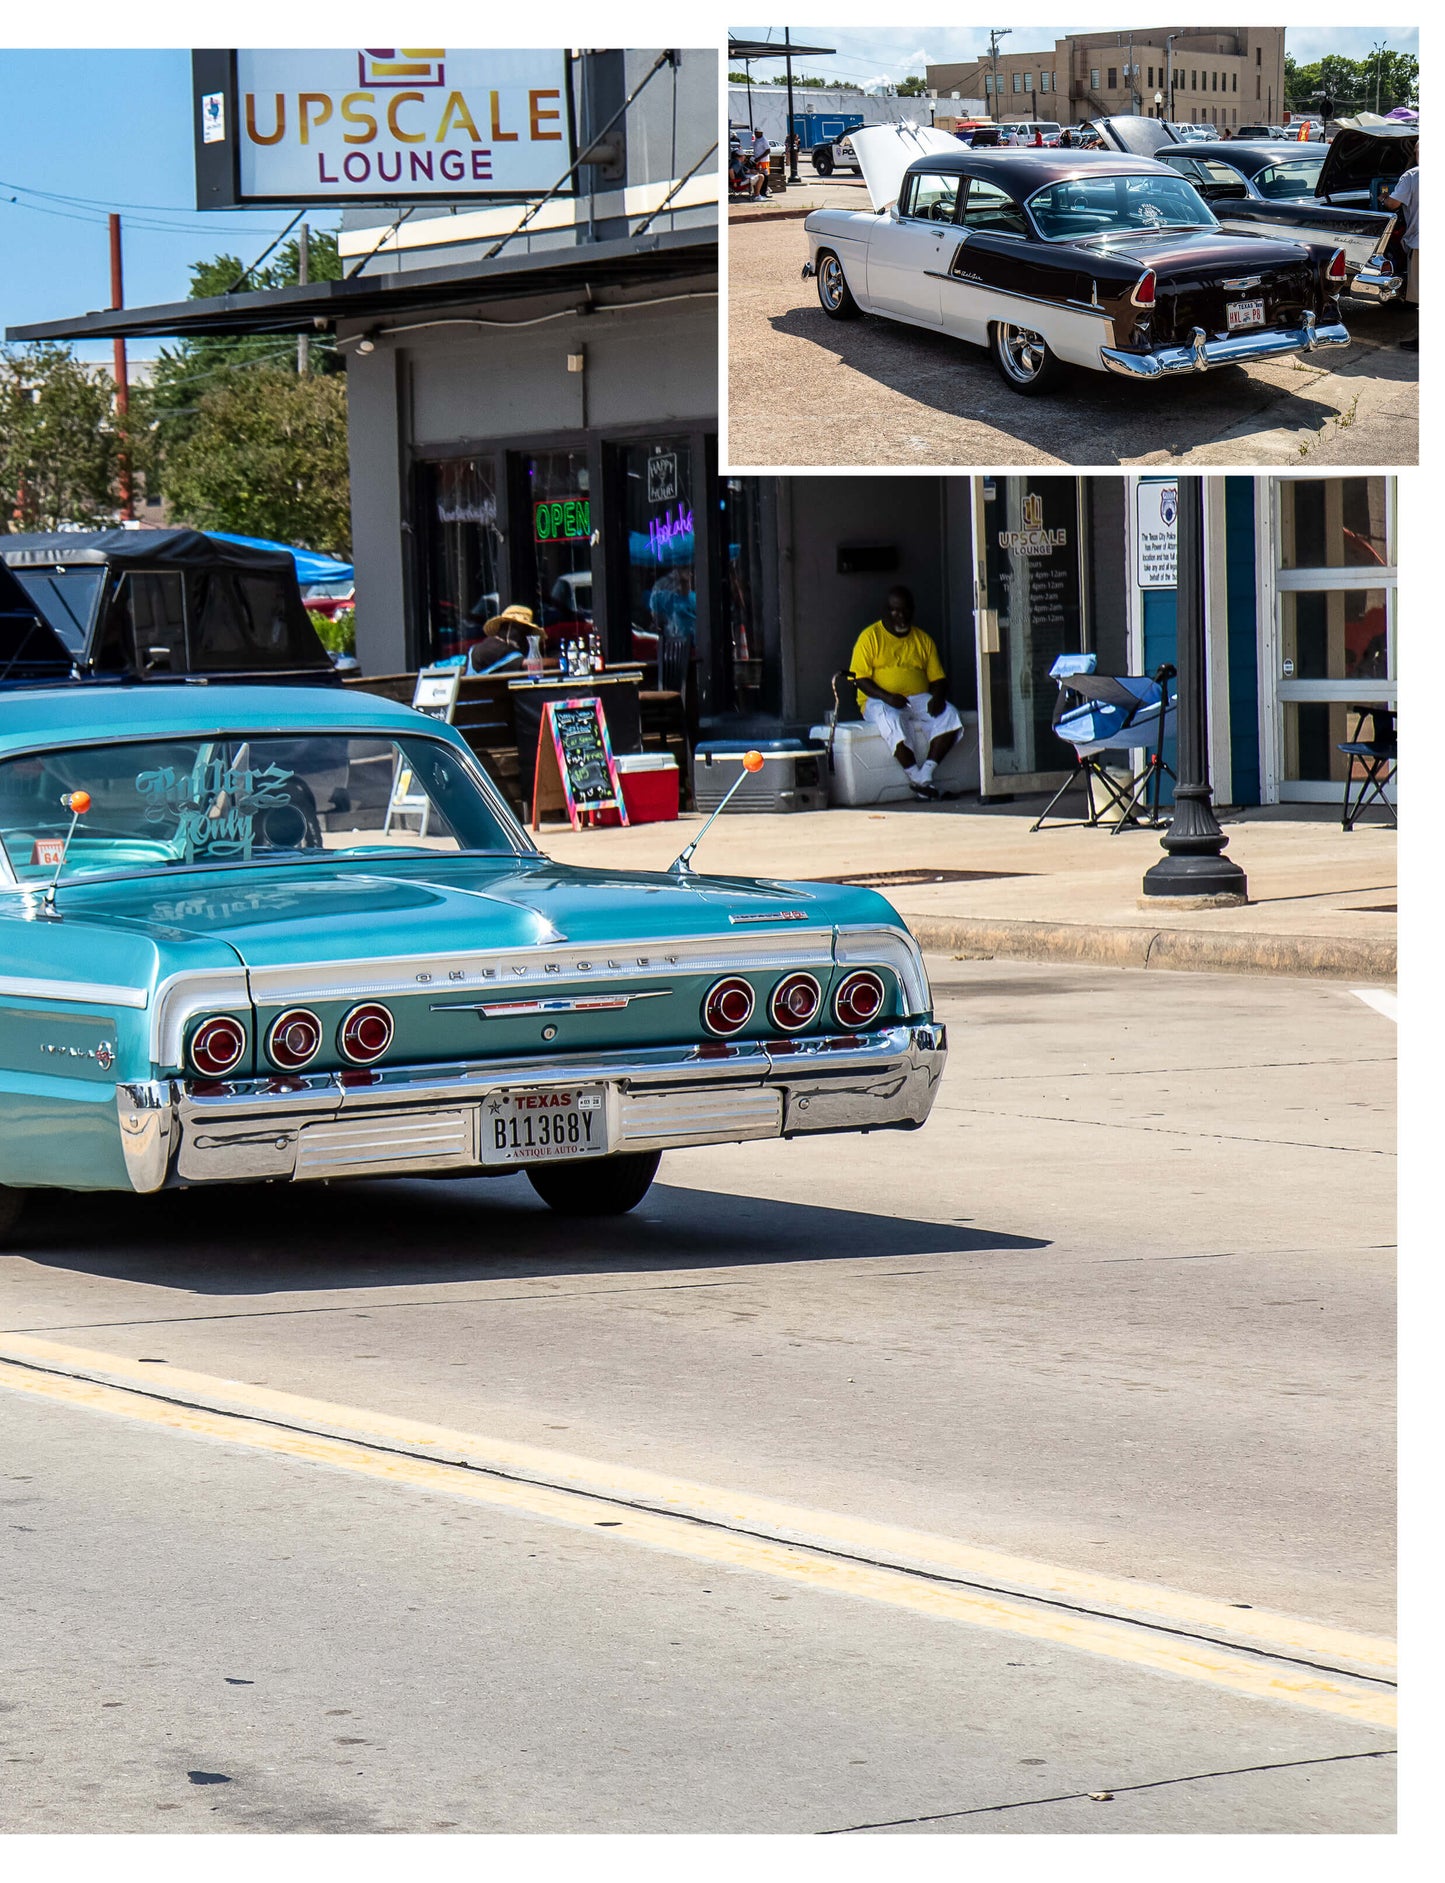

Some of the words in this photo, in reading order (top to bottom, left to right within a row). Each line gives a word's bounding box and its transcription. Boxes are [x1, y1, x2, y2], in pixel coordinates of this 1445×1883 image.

[245, 90, 562, 145] UPSCALE
[318, 150, 493, 183] LOUNGE
[536, 501, 590, 539] OPEN
[999, 529, 1066, 548] UPSCALE
[1014, 545, 1052, 555] LOUNGE
[185, 808, 256, 856] Only
[44, 852, 60, 864] 64
[416, 955, 679, 982] CHEVROLET
[515, 1093, 572, 1110] TEXAS
[494, 1111, 593, 1150] B11368Y
[513, 1147, 552, 1158] ANTIQUE
[555, 1145, 578, 1155] AUTO
